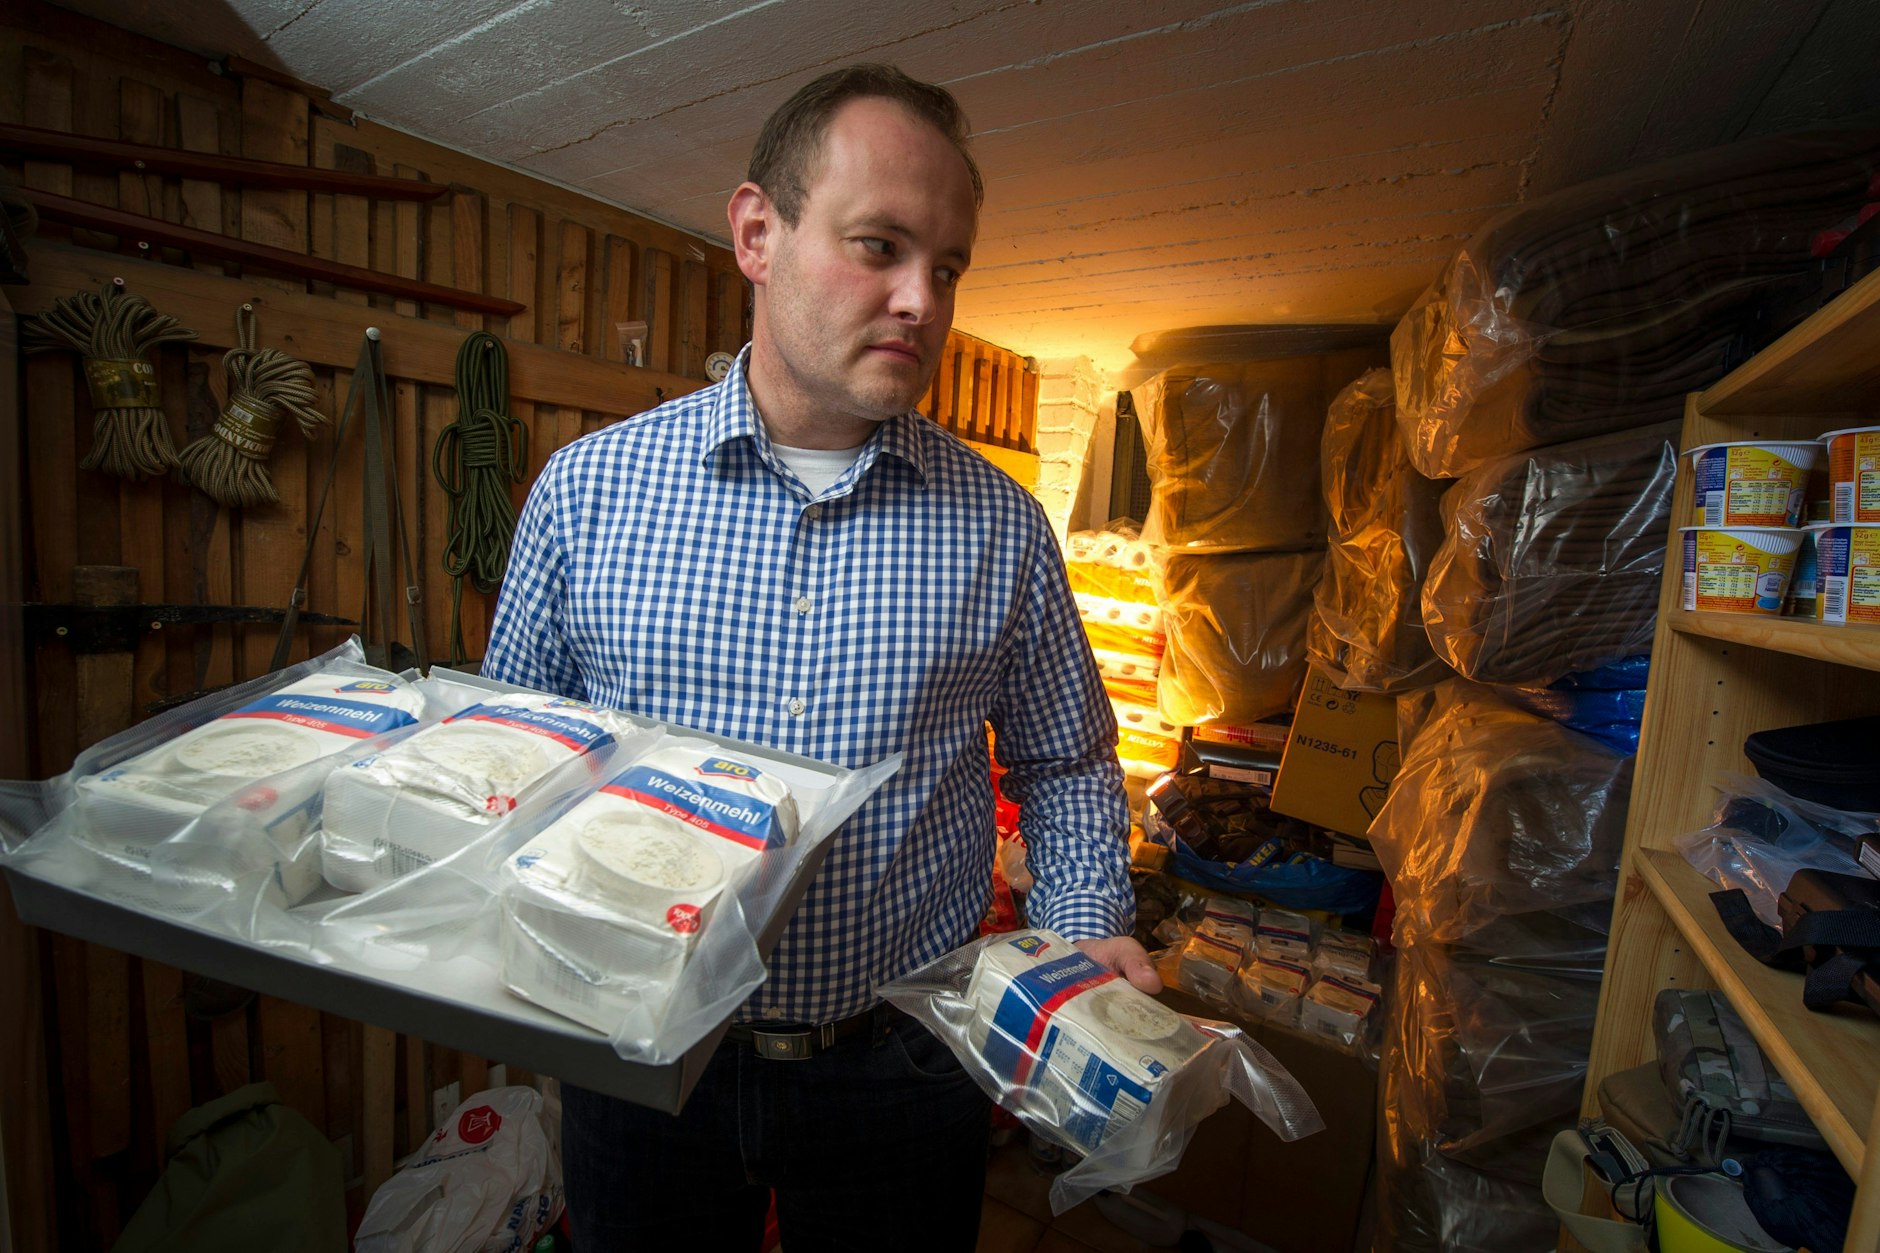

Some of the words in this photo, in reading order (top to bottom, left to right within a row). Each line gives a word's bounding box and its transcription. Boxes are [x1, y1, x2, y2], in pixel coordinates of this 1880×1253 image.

[355, 682, 388, 690] aro
[276, 698, 383, 722] Weizenmehl
[281, 713, 308, 726] Type
[308, 719, 328, 729] 405
[1296, 734, 1357, 760] N1235-61
[713, 760, 748, 776] aro
[647, 775, 760, 825] Weizenmehl
[663, 803, 688, 820] Type
[688, 815, 709, 829] 405
[1249, 842, 1277, 867] IKEA
[1017, 937, 1039, 949] aro
[1038, 959, 1095, 984] Weizenmehl
